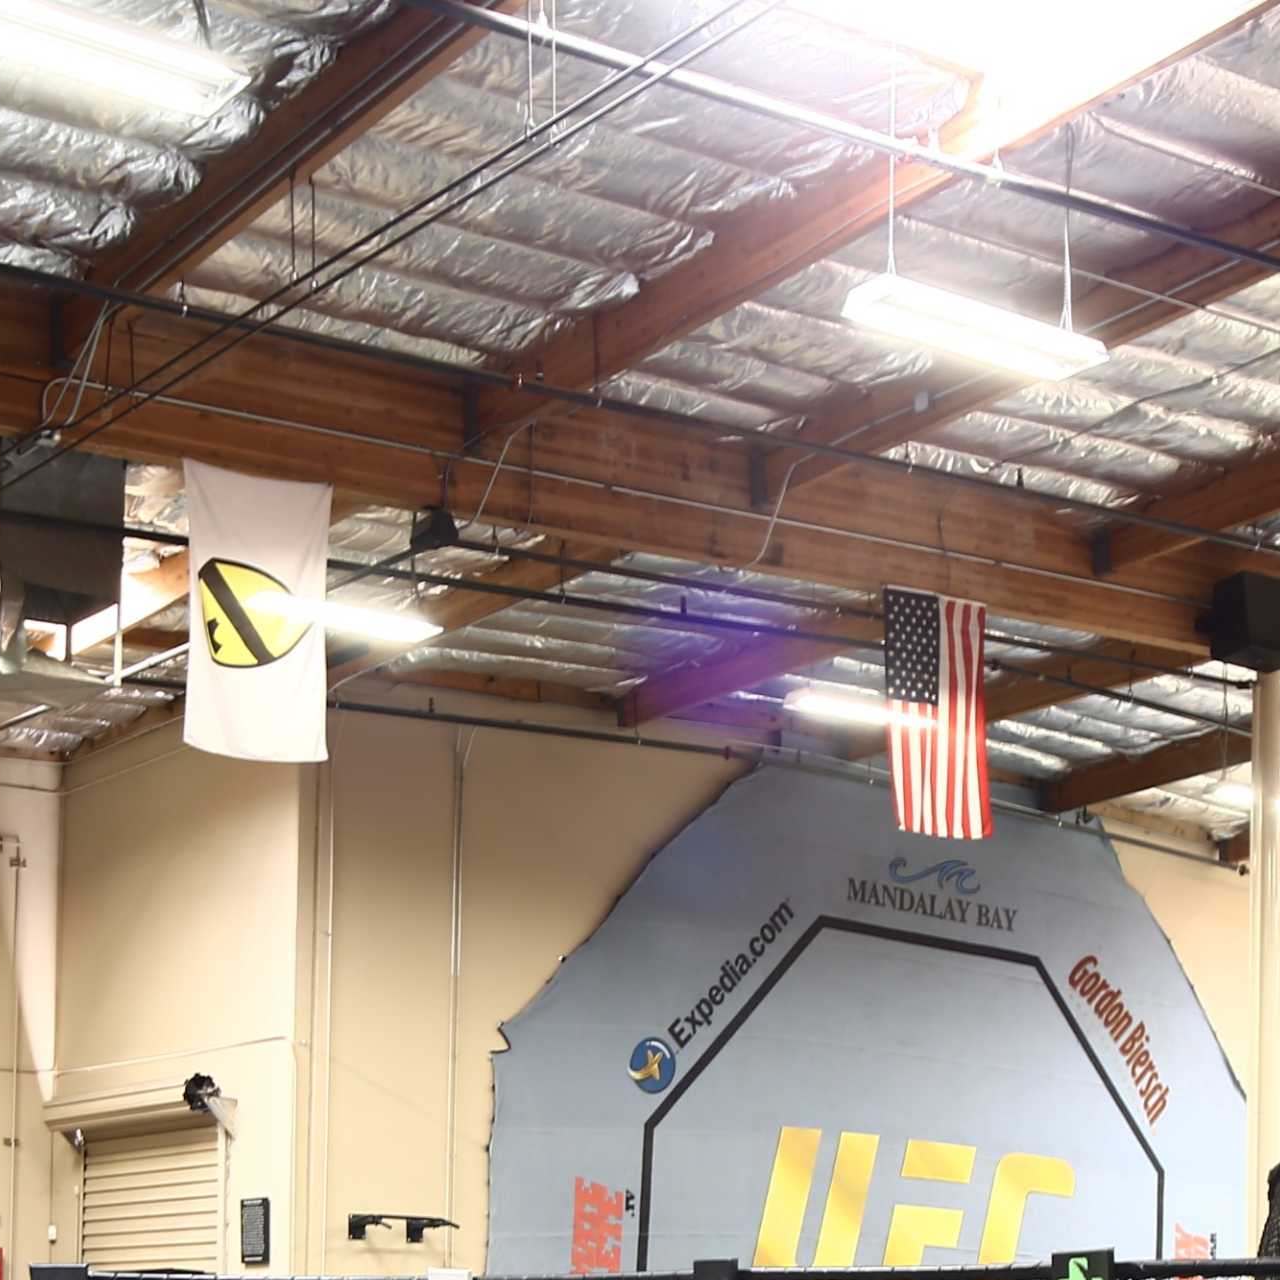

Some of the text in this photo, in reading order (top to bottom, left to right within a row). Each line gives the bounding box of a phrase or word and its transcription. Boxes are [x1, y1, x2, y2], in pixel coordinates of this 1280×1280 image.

[667, 899, 795, 1049] Expedia.com
[847, 876, 1018, 931] MANDALAY BAY
[1068, 955, 1170, 1127] Gordon Biersch
